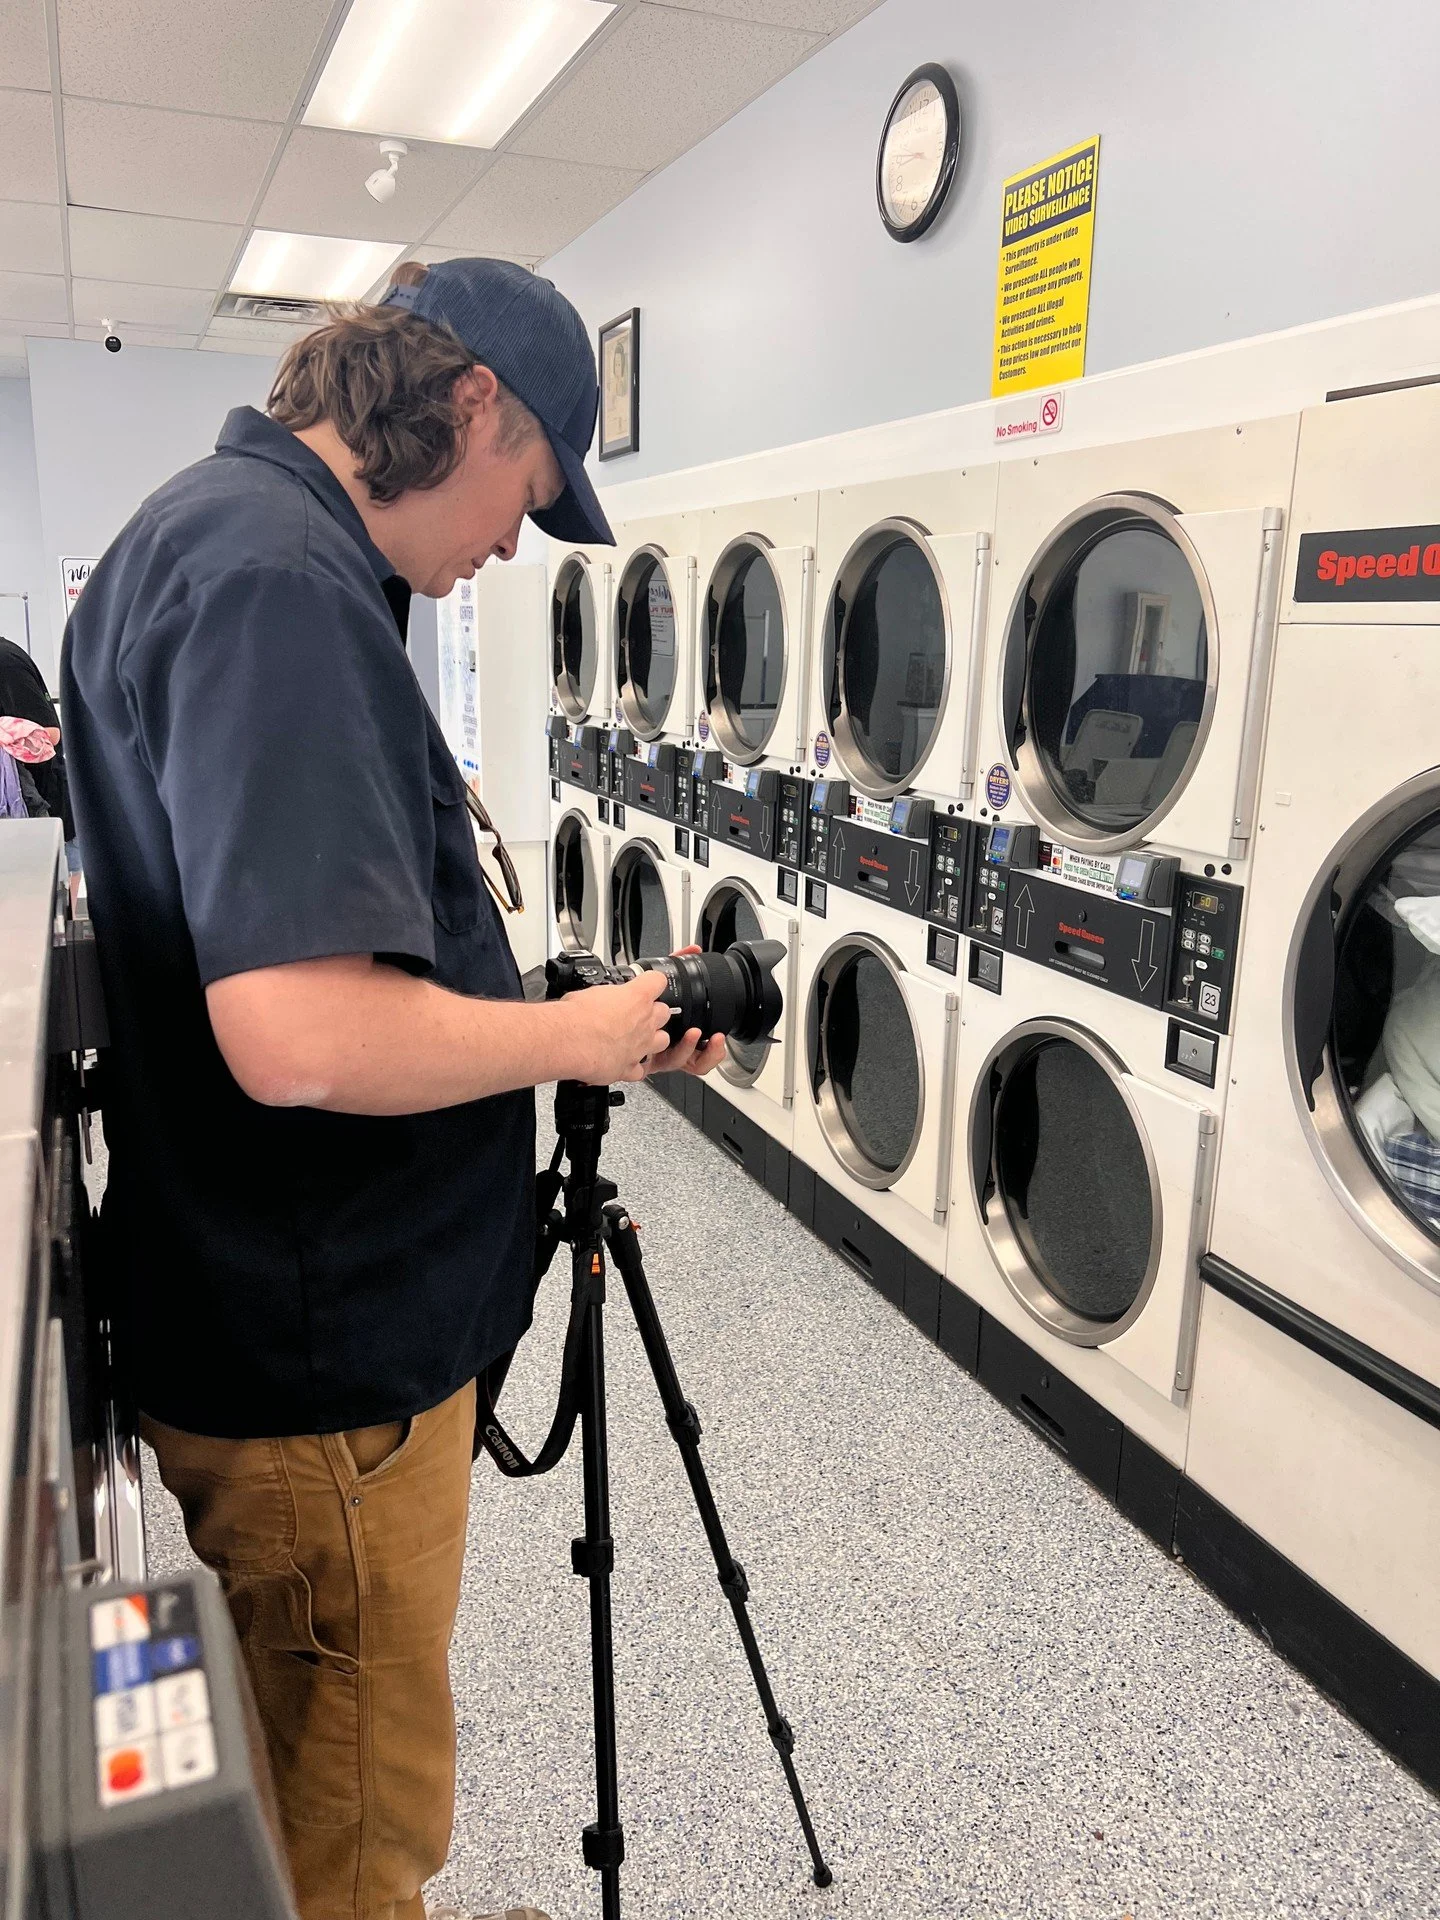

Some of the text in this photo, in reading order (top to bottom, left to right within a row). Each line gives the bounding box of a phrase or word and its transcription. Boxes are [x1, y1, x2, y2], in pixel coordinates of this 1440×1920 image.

[919, 99, 930, 114] 12
[896, 176, 903, 191] 8
[1005, 155, 1093, 217] PLEASE NOTICE
[911, 199, 918, 211] 6
[1005, 185, 1090, 237] VIDEO SURVEILLANCE
[1006, 226, 1079, 262] This property is under video
[1004, 258, 1080, 292] We prosecute ALL people who
[1003, 271, 1083, 306] Abuse or damage any property.
[1002, 296, 1064, 325] We prosecute ALL illegal
[1000, 323, 1082, 354] This action is necessary to help
[1001, 315, 1055, 339] Activities and crimes.
[1000, 338, 1081, 367] Keep prices low and protect our
[999, 367, 1027, 380] Customers.
[996, 420, 1038, 437] No Smoking
[1317, 545, 1420, 585] Speed
[990, 776, 1009, 785] DRYERS
[1069, 854, 1081, 863] WHEN
[1081, 857, 1094, 867] PAYING
[1100, 863, 1111, 871] CARD
[1058, 922, 1105, 945] Speed Queen
[1205, 992, 1216, 1007] 23
[485, 1424, 520, 1469] Canon
